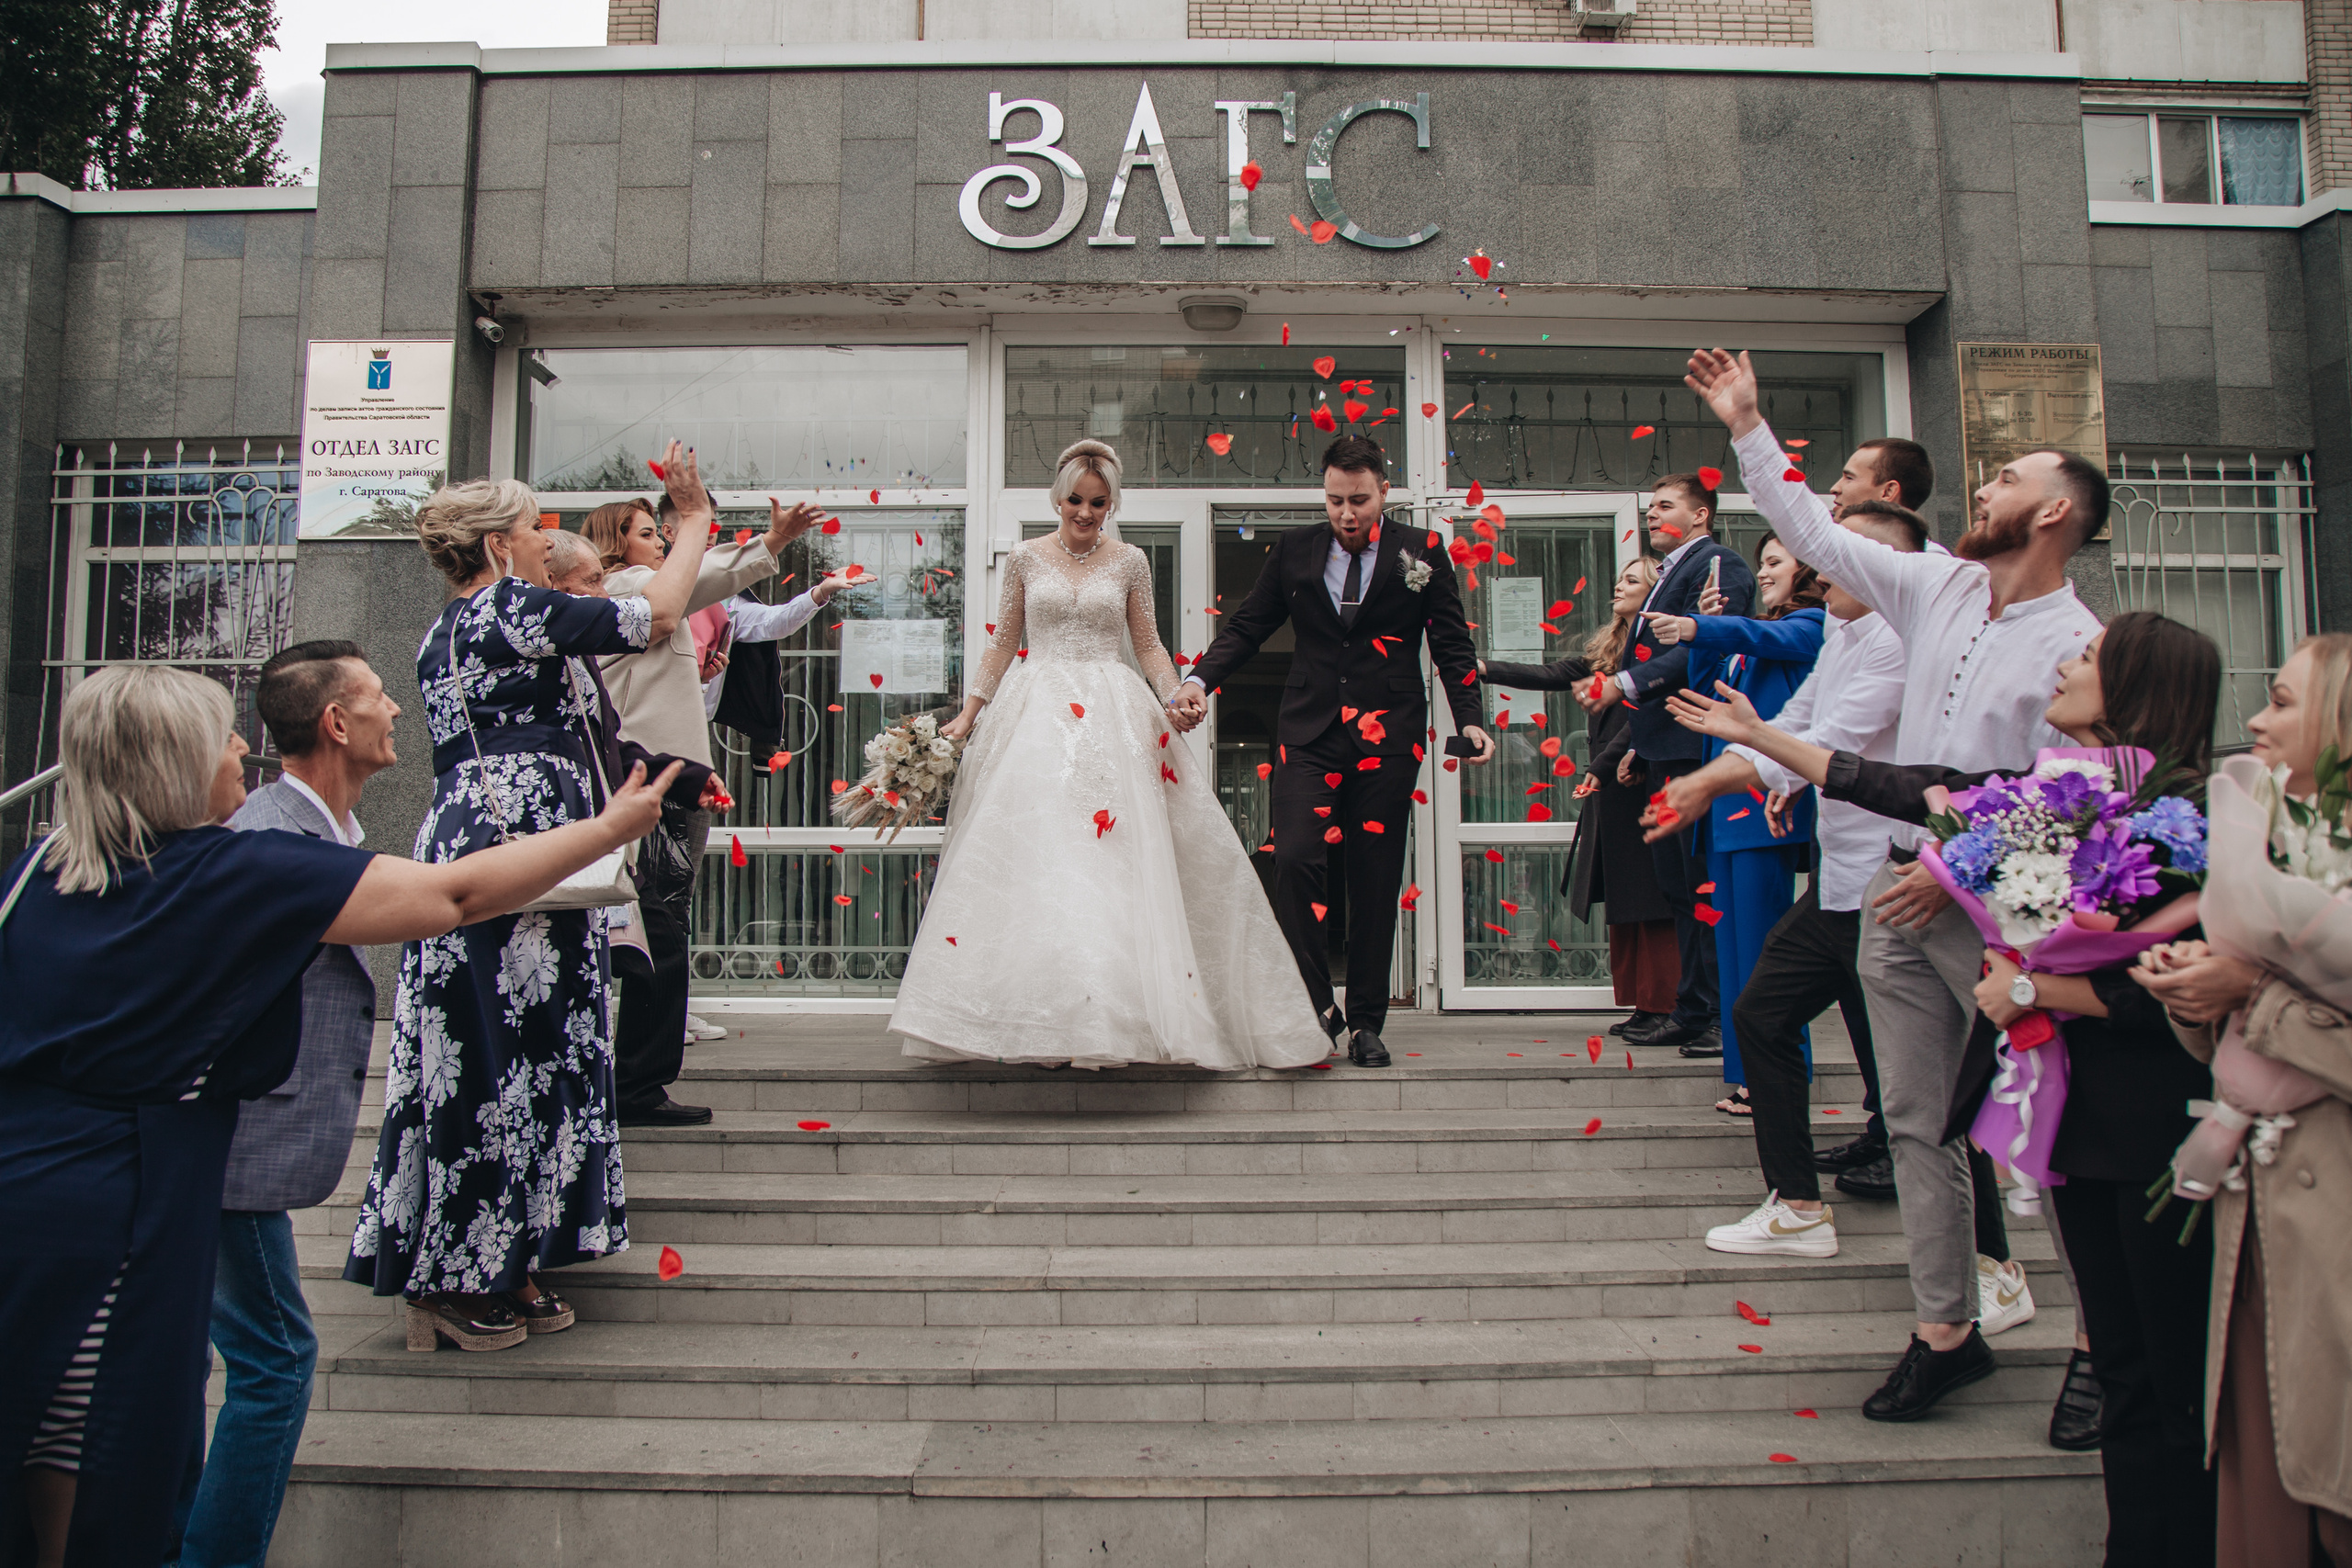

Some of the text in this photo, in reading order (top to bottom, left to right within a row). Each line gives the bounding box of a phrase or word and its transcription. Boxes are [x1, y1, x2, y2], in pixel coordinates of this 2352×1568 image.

[958, 80, 1442, 248] ЗАГС
[1969, 347, 2089, 360] РЕЖИМ РАБОТЫ
[368, 413, 406, 422] Саратовской
[311, 439, 440, 458] ОТДЕЛ ЗАГС
[306, 467, 442, 479] по Заводскому району
[339, 485, 407, 498] г. Саратова
